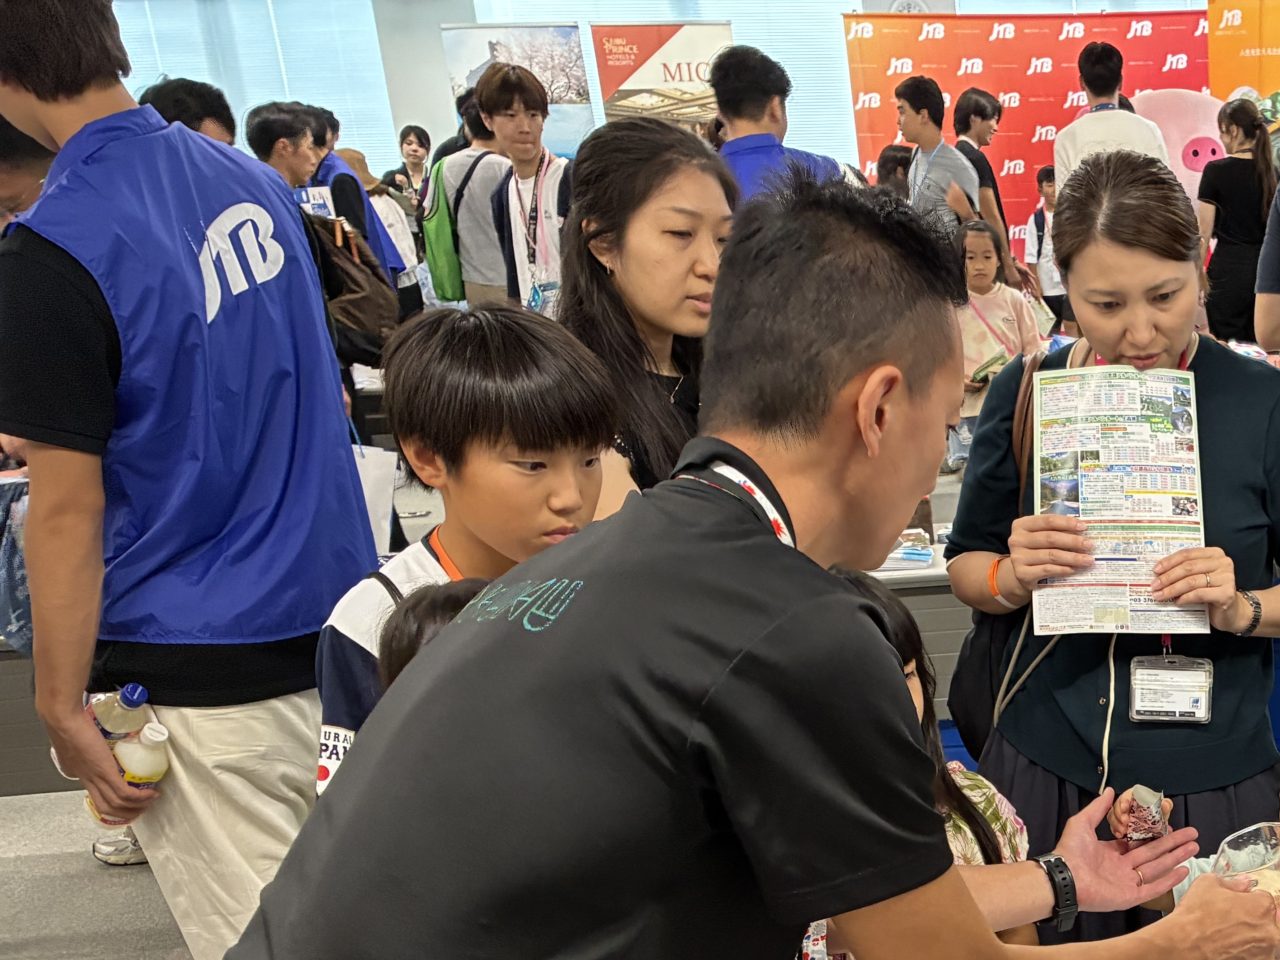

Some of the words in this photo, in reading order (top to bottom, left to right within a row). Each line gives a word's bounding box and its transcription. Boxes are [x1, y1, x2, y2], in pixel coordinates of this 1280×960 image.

[1219, 9, 1242, 29] JTB
[848, 22, 873, 40] JTB
[919, 22, 944, 41] JTB
[989, 22, 1015, 41] JTB
[1059, 22, 1085, 41] JTB
[1126, 20, 1152, 39] JTB
[604, 44, 639, 54] PRINCE
[887, 57, 912, 76] JTB
[957, 57, 983, 76] JTB
[1027, 57, 1053, 75] JTB
[1162, 53, 1188, 72] JTB
[855, 92, 881, 110] JTB
[1031, 125, 1057, 143] JTB
[1000, 159, 1025, 176] JTB
[198, 202, 286, 324] JTB
